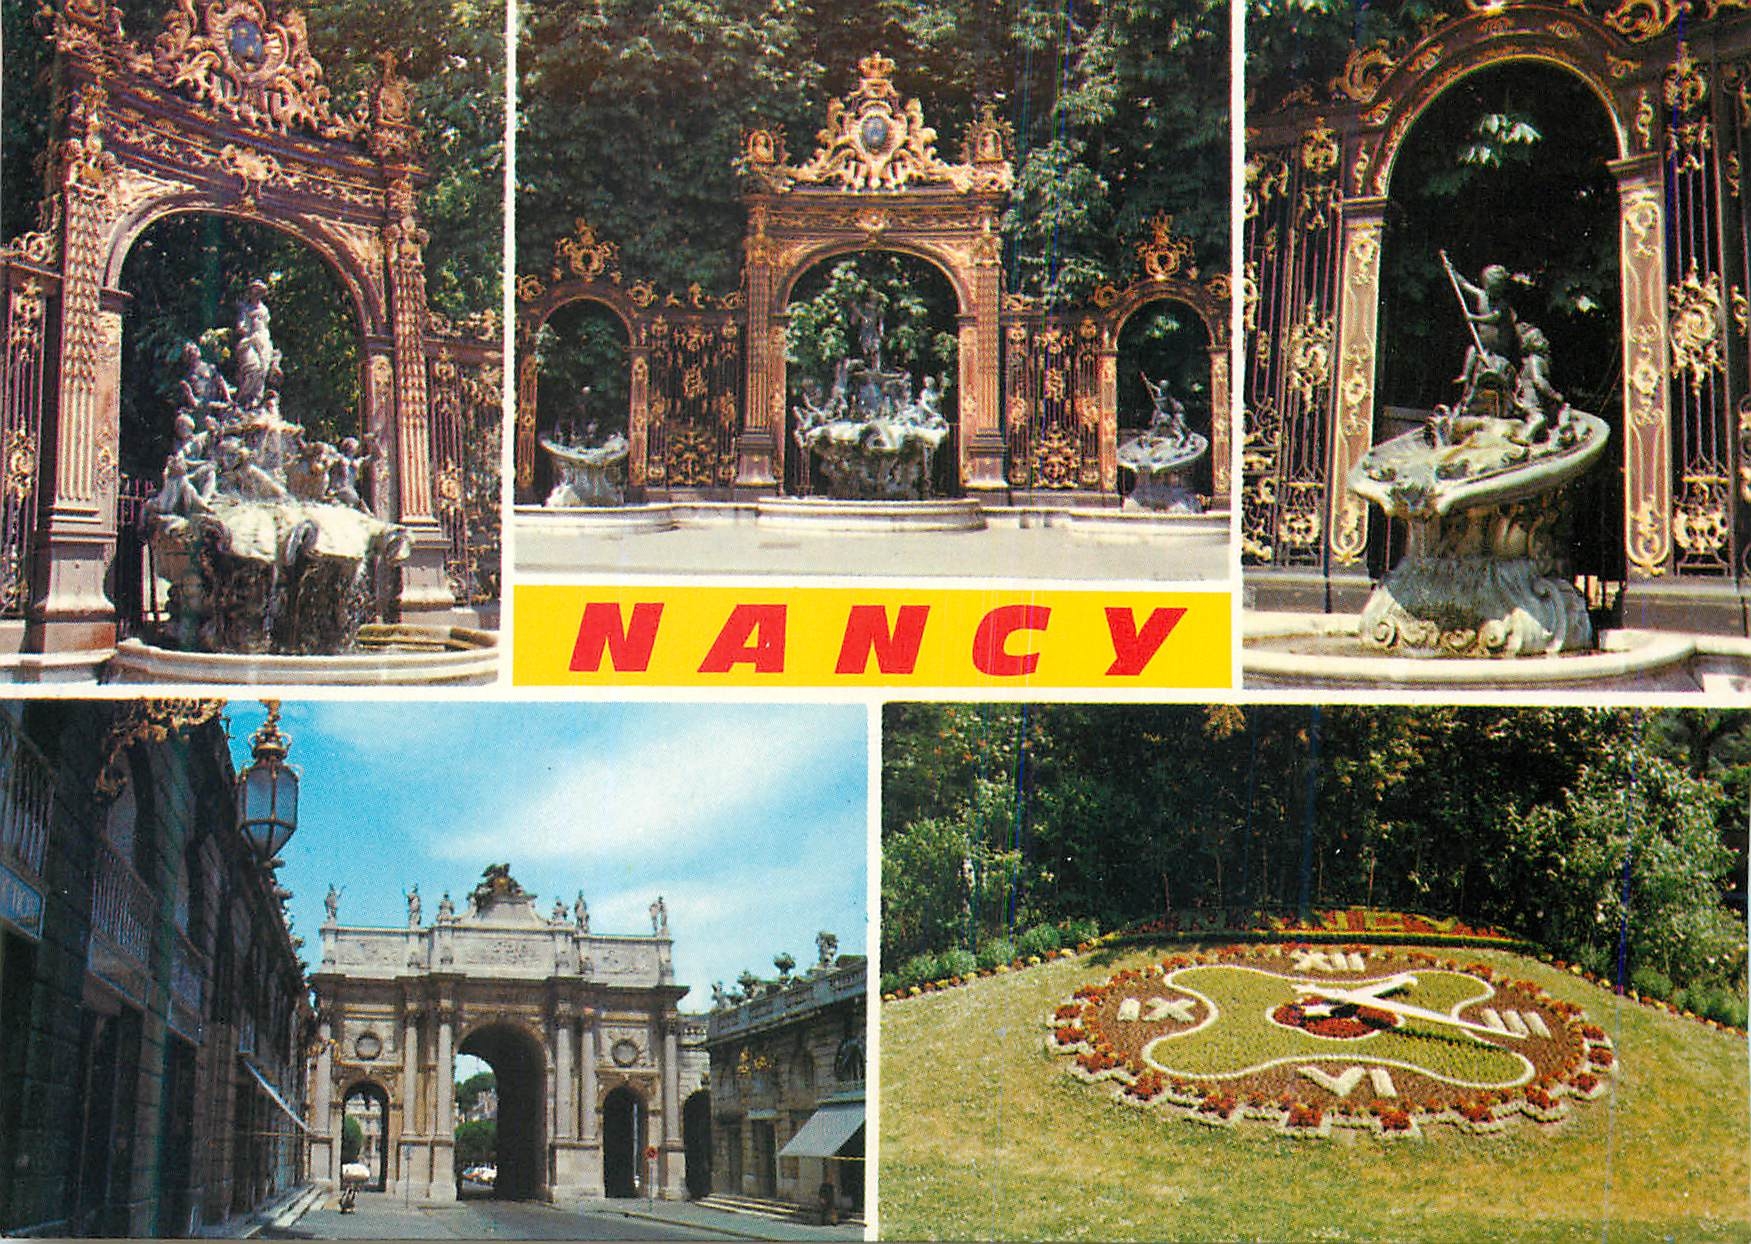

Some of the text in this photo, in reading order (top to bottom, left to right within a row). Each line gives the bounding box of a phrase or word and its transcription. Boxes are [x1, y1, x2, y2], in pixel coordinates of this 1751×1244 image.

[1290, 949, 1366, 972] XII
[1117, 997, 1196, 1021] IX
[1480, 1008, 1551, 1038] III
[1297, 1066, 1398, 1098] VI
